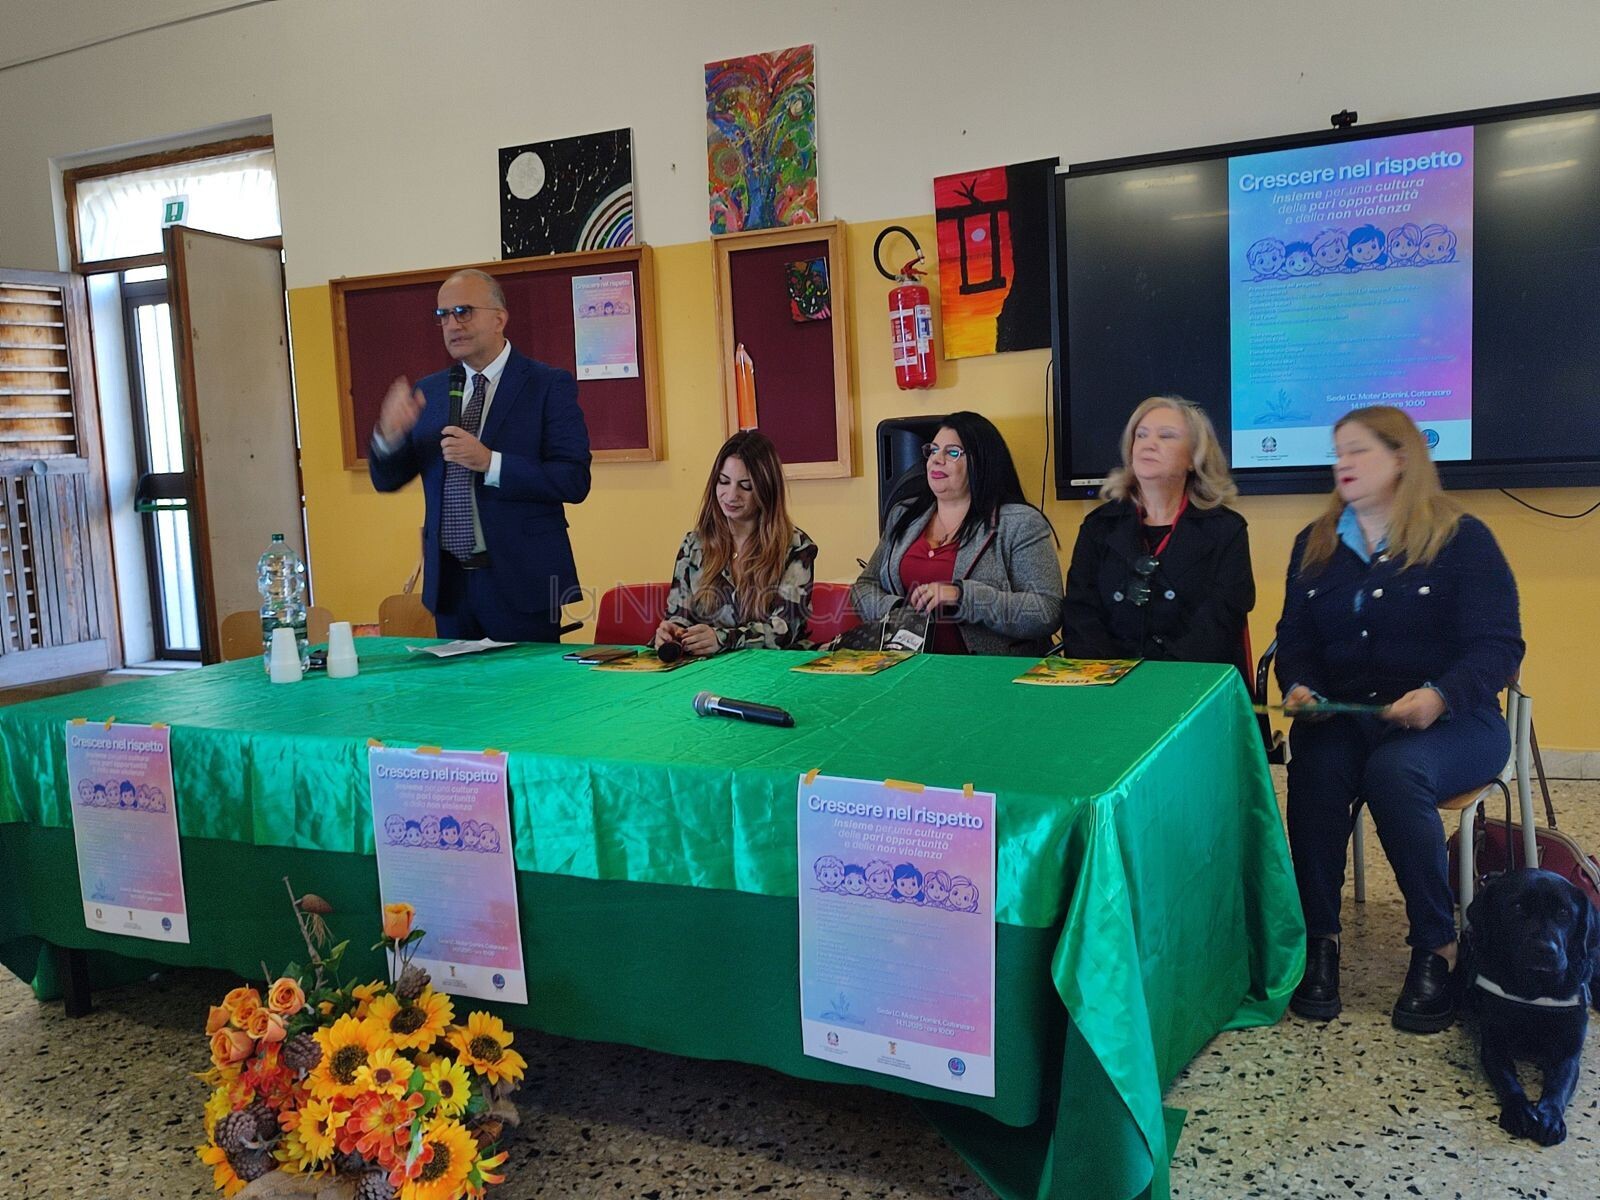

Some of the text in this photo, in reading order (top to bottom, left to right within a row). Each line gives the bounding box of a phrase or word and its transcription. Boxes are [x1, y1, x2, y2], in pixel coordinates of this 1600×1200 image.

[1239, 150, 1463, 192] Crescere nel rispetto
[1325, 187, 1346, 200] per
[1349, 184, 1372, 195] una
[1375, 178, 1425, 192] cultura
[1278, 188, 1419, 215] delle pari opportunità
[1295, 211, 1324, 224] della
[1327, 210, 1351, 221] non
[1355, 203, 1411, 217] violenza
[72, 735, 164, 753] Crescere nel rispetto
[376, 763, 498, 785] Crescere nel rispetto
[807, 793, 983, 830] Crescere nel rispetto
[863, 832, 884, 842] pari
[875, 824, 892, 834] per
[893, 826, 913, 836] una
[914, 827, 954, 841] cultura
[877, 844, 896, 854] non
[898, 846, 943, 860] violenza
